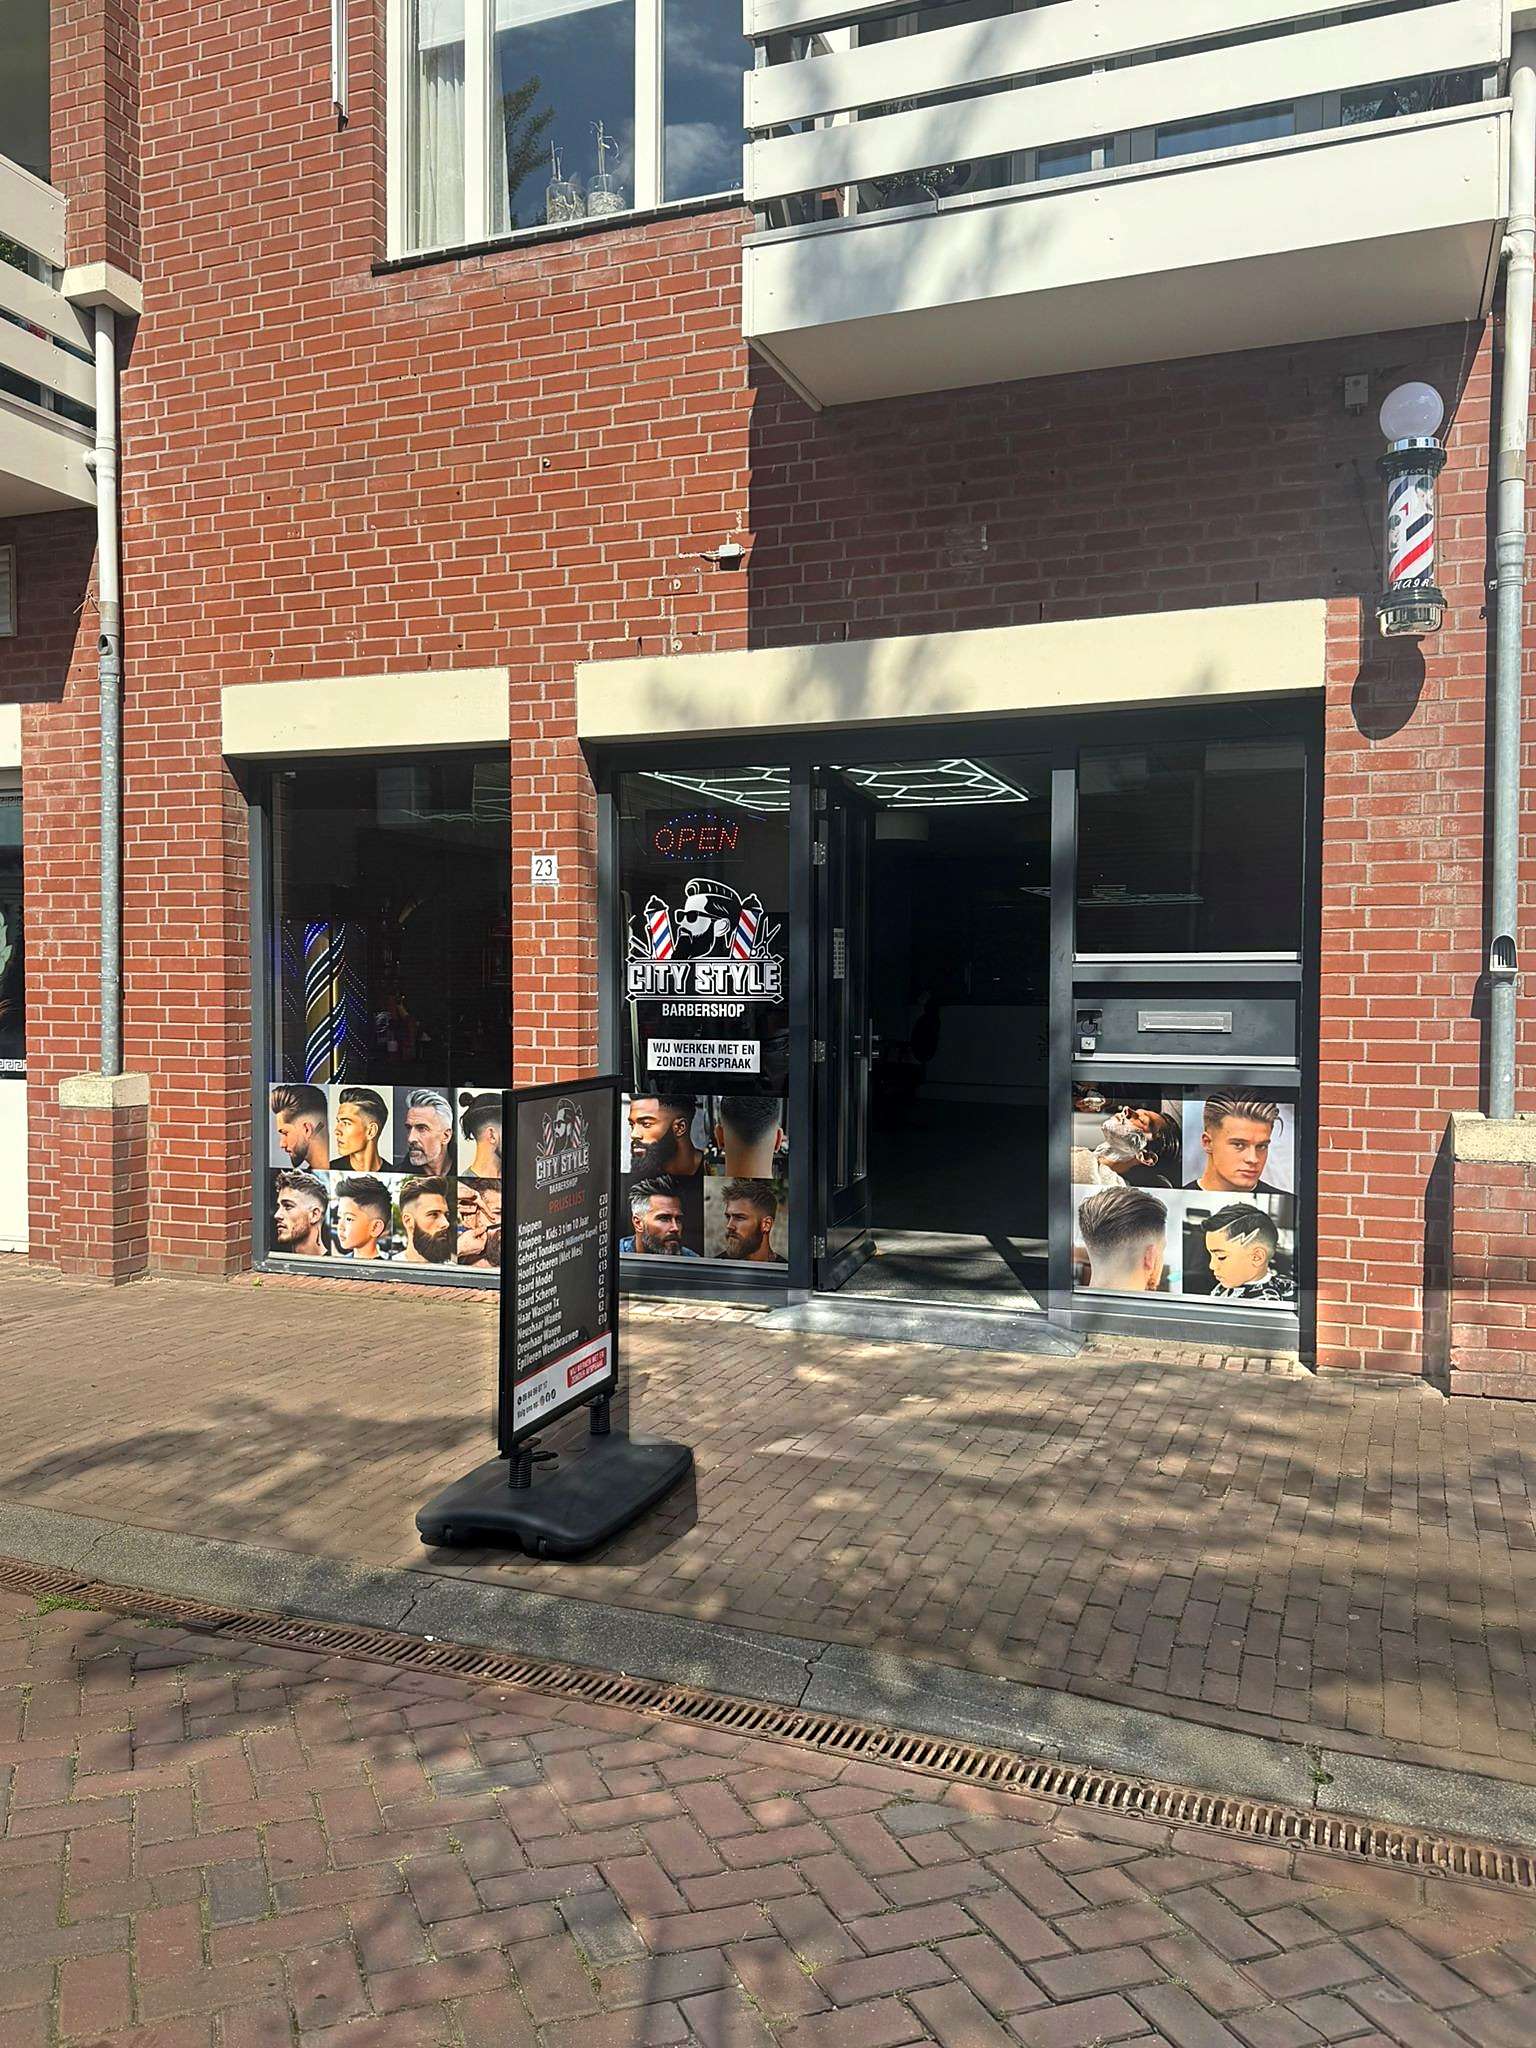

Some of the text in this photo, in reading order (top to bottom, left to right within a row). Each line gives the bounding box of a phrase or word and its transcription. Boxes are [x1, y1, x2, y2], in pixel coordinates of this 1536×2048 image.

[655, 826, 739, 851] OPEN
[535, 858, 553, 877] 23
[627, 962, 782, 995] CITY STYLE
[662, 1003, 745, 1018] BARBERSHOP
[653, 1043, 755, 1055] WIJ WERKEN MET EN
[656, 1056, 751, 1069] ZONDER AFSPRAAK
[536, 1149, 590, 1180] CITY STYLE
[549, 1177, 579, 1195] BARBERSHOP
[518, 1220, 542, 1236] Knippen
[518, 1235, 542, 1251] Knippen
[546, 1227, 558, 1240] Kids
[558, 1225, 563, 1236] 3
[572, 1217, 579, 1230] 10
[518, 1247, 538, 1266] Geheel
[539, 1240, 564, 1257] Tondeuse
[518, 1263, 535, 1281] Hoofd
[535, 1257, 559, 1273] Scheren
[518, 1277, 535, 1296] Baard
[535, 1270, 554, 1288] Model
[518, 1292, 535, 1311] Baard
[535, 1285, 557, 1303] Scheren
[518, 1311, 531, 1326] Haar
[532, 1302, 552, 1319] Wassen
[518, 1320, 544, 1341] Neushaar
